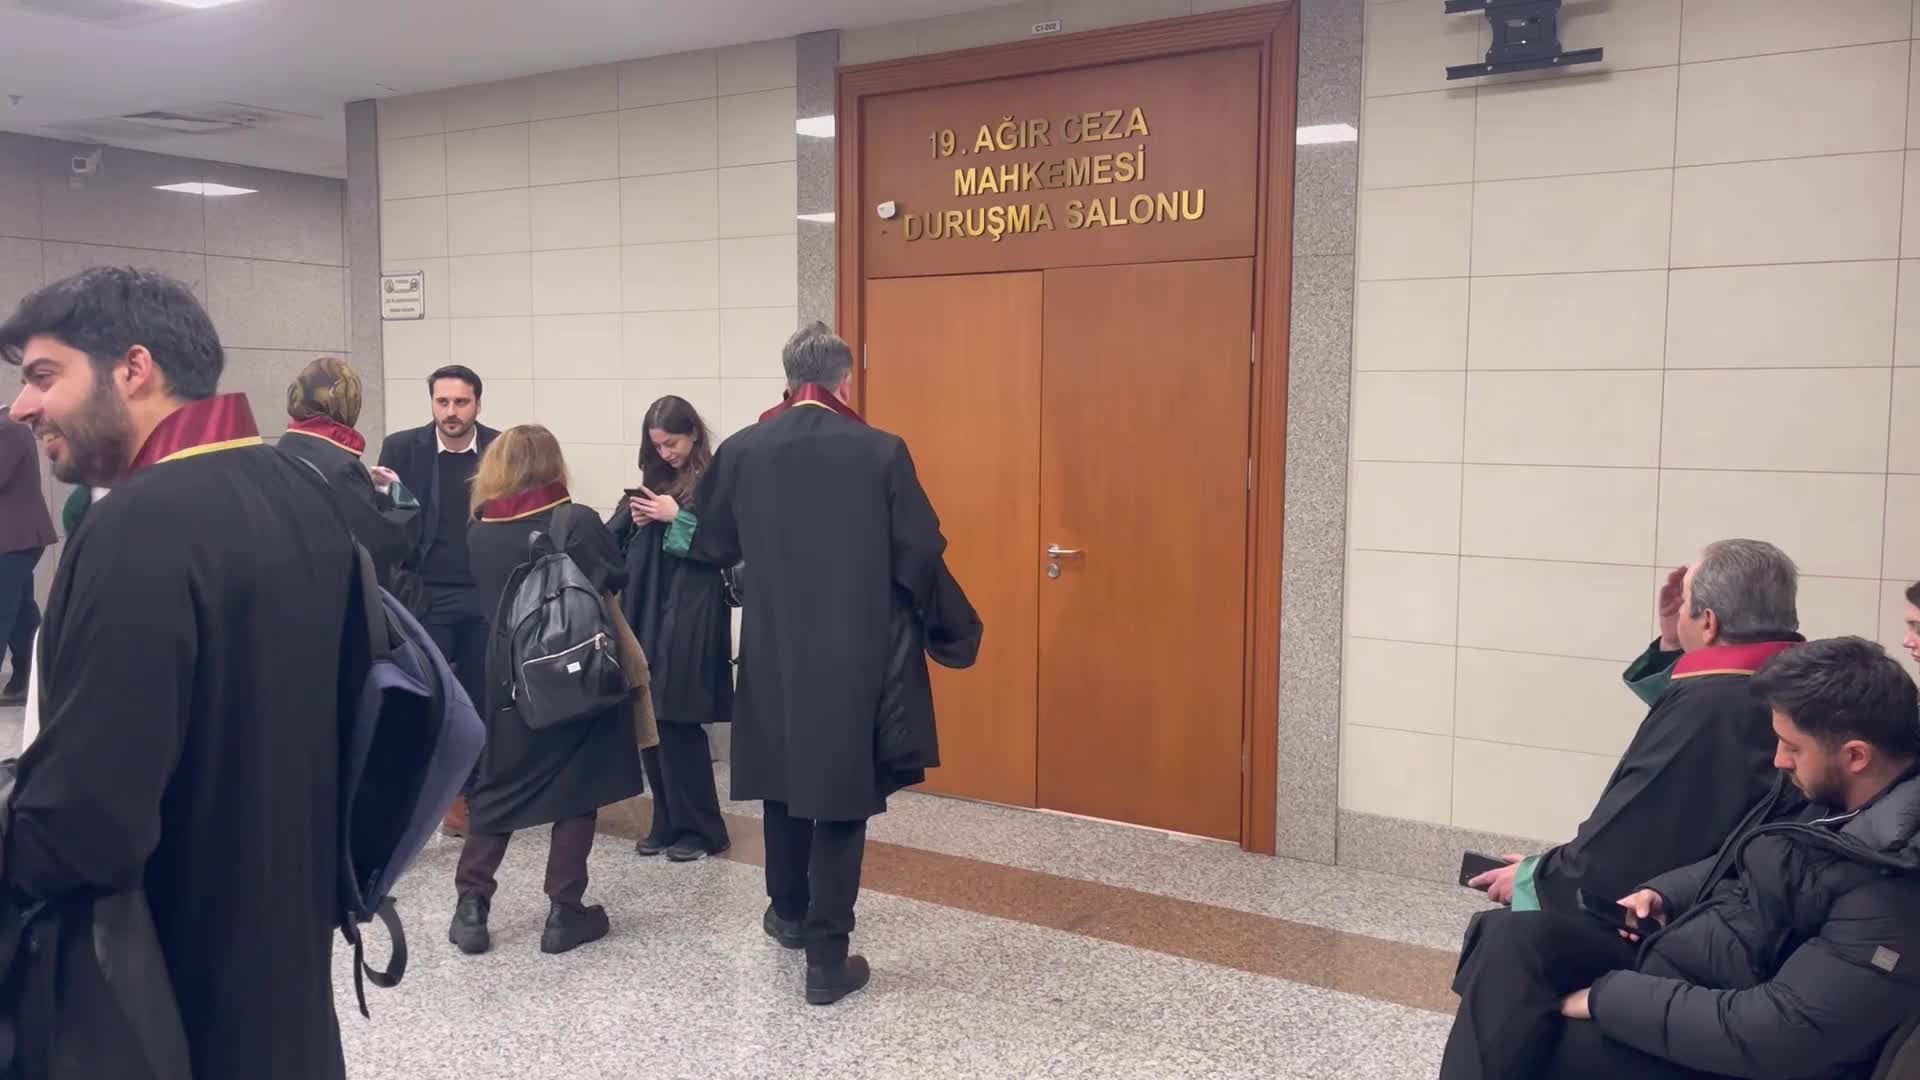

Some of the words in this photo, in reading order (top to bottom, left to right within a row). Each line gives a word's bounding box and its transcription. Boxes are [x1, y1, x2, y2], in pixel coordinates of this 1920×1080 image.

[928, 128, 967, 159] 19.
[974, 114, 1050, 154] AĞIR
[1061, 107, 1150, 145] CEZA
[953, 144, 1146, 197] MAHKEMESİ
[903, 203, 1056, 243] DURUŞMA
[1065, 189, 1206, 230] SALONU
